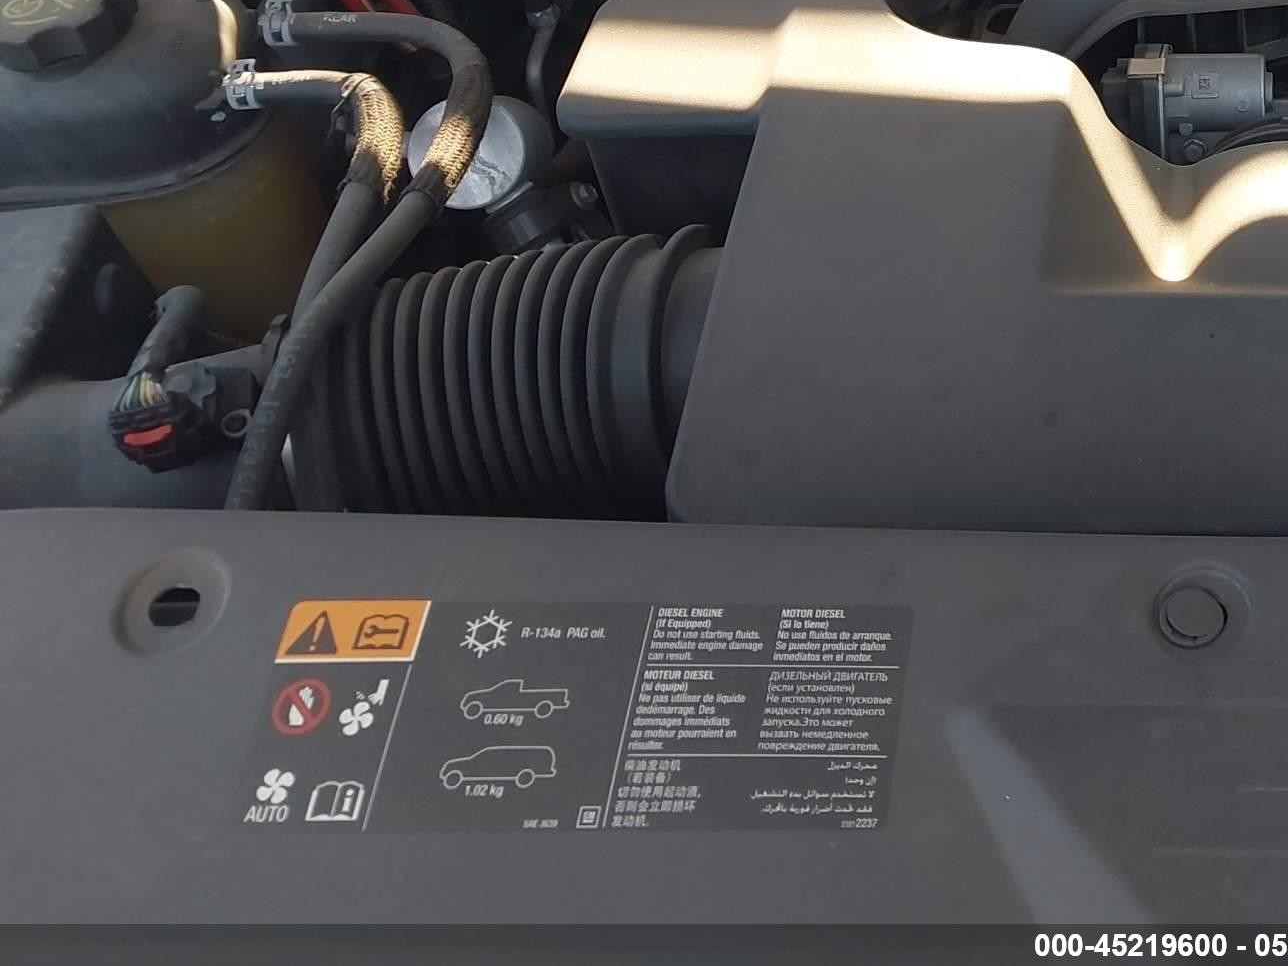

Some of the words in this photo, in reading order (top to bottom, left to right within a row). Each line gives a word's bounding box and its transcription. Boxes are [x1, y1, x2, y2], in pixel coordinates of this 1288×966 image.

[658, 607, 689, 618] DIESEL
[691, 608, 724, 618] ENGINE
[781, 608, 814, 619] MOTOR
[815, 609, 846, 619] DIESEL
[656, 618, 666, 629] (If
[667, 618, 711, 629] Equipped)
[780, 619, 792, 630] (Si
[804, 620, 829, 630] tiene)
[521, 627, 561, 639] R-134a
[566, 627, 588, 639] PAG
[653, 629, 665, 639] Do
[666, 630, 681, 639] not
[682, 631, 699, 640] use
[700, 630, 733, 641] starting
[735, 630, 761, 640] fluids.
[777, 630, 790, 640] No
[791, 631, 807, 640] use
[809, 630, 838, 640] fluidos
[839, 631, 851, 640] de
[852, 632, 893, 642] arranque.
[650, 640, 696, 650] Immediate
[697, 640, 727, 652] engine
[728, 641, 763, 652] damage
[775, 641, 787, 651] Se
[788, 642, 821, 652] pueden
[822, 641, 858, 652] producir
[860, 641, 887, 652] daños
[647, 652, 664, 661] can
[665, 651, 694, 661] result.
[822, 654, 834, 662] en
[835, 652, 844, 662] el
[845, 653, 873, 662] motor.
[643, 670, 682, 681] MOTEUR
[683, 670, 715, 681] DIESEL
[769, 669, 832, 682] ДИЗЕЛЬНЫЙ
[832, 671, 888, 682] ДВИГАТЕЛЬ
[641, 681, 653, 693] (si
[654, 681, 688, 693] équipé)
[767, 682, 794, 694] (если
[796, 682, 855, 694] установлен)
[638, 693, 651, 703] Ne
[652, 694, 669, 705] pas
[670, 693, 701, 703] utiliser
[702, 693, 714, 703] de
[716, 694, 746, 705] liquide
[765, 694, 780, 704] Не
[781, 694, 843, 707] используйте
[845, 696, 893, 706] пусковые
[698, 704, 716, 715] Des
[763, 706, 812, 716] жидкости
[812, 707, 832, 716] для
[833, 707, 885, 717] холодного
[483, 713, 508, 725] 0.60
[509, 713, 524, 726] kg
[633, 716, 682, 728] dommages
[684, 715, 730, 727] immédiats
[821, 719, 854, 727] может
[630, 729, 643, 738] au
[644, 728, 676, 738] moteur
[677, 728, 723, 740] pourraient
[725, 729, 737, 738] en
[759, 729, 799, 739] вызвать
[801, 730, 869, 740] немедленное
[757, 742, 826, 753] повреждение
[827, 742, 880, 753] двигателя.
[464, 785, 488, 797] 1.02
[489, 784, 504, 799] kg
[243, 805, 290, 822] AUTO
